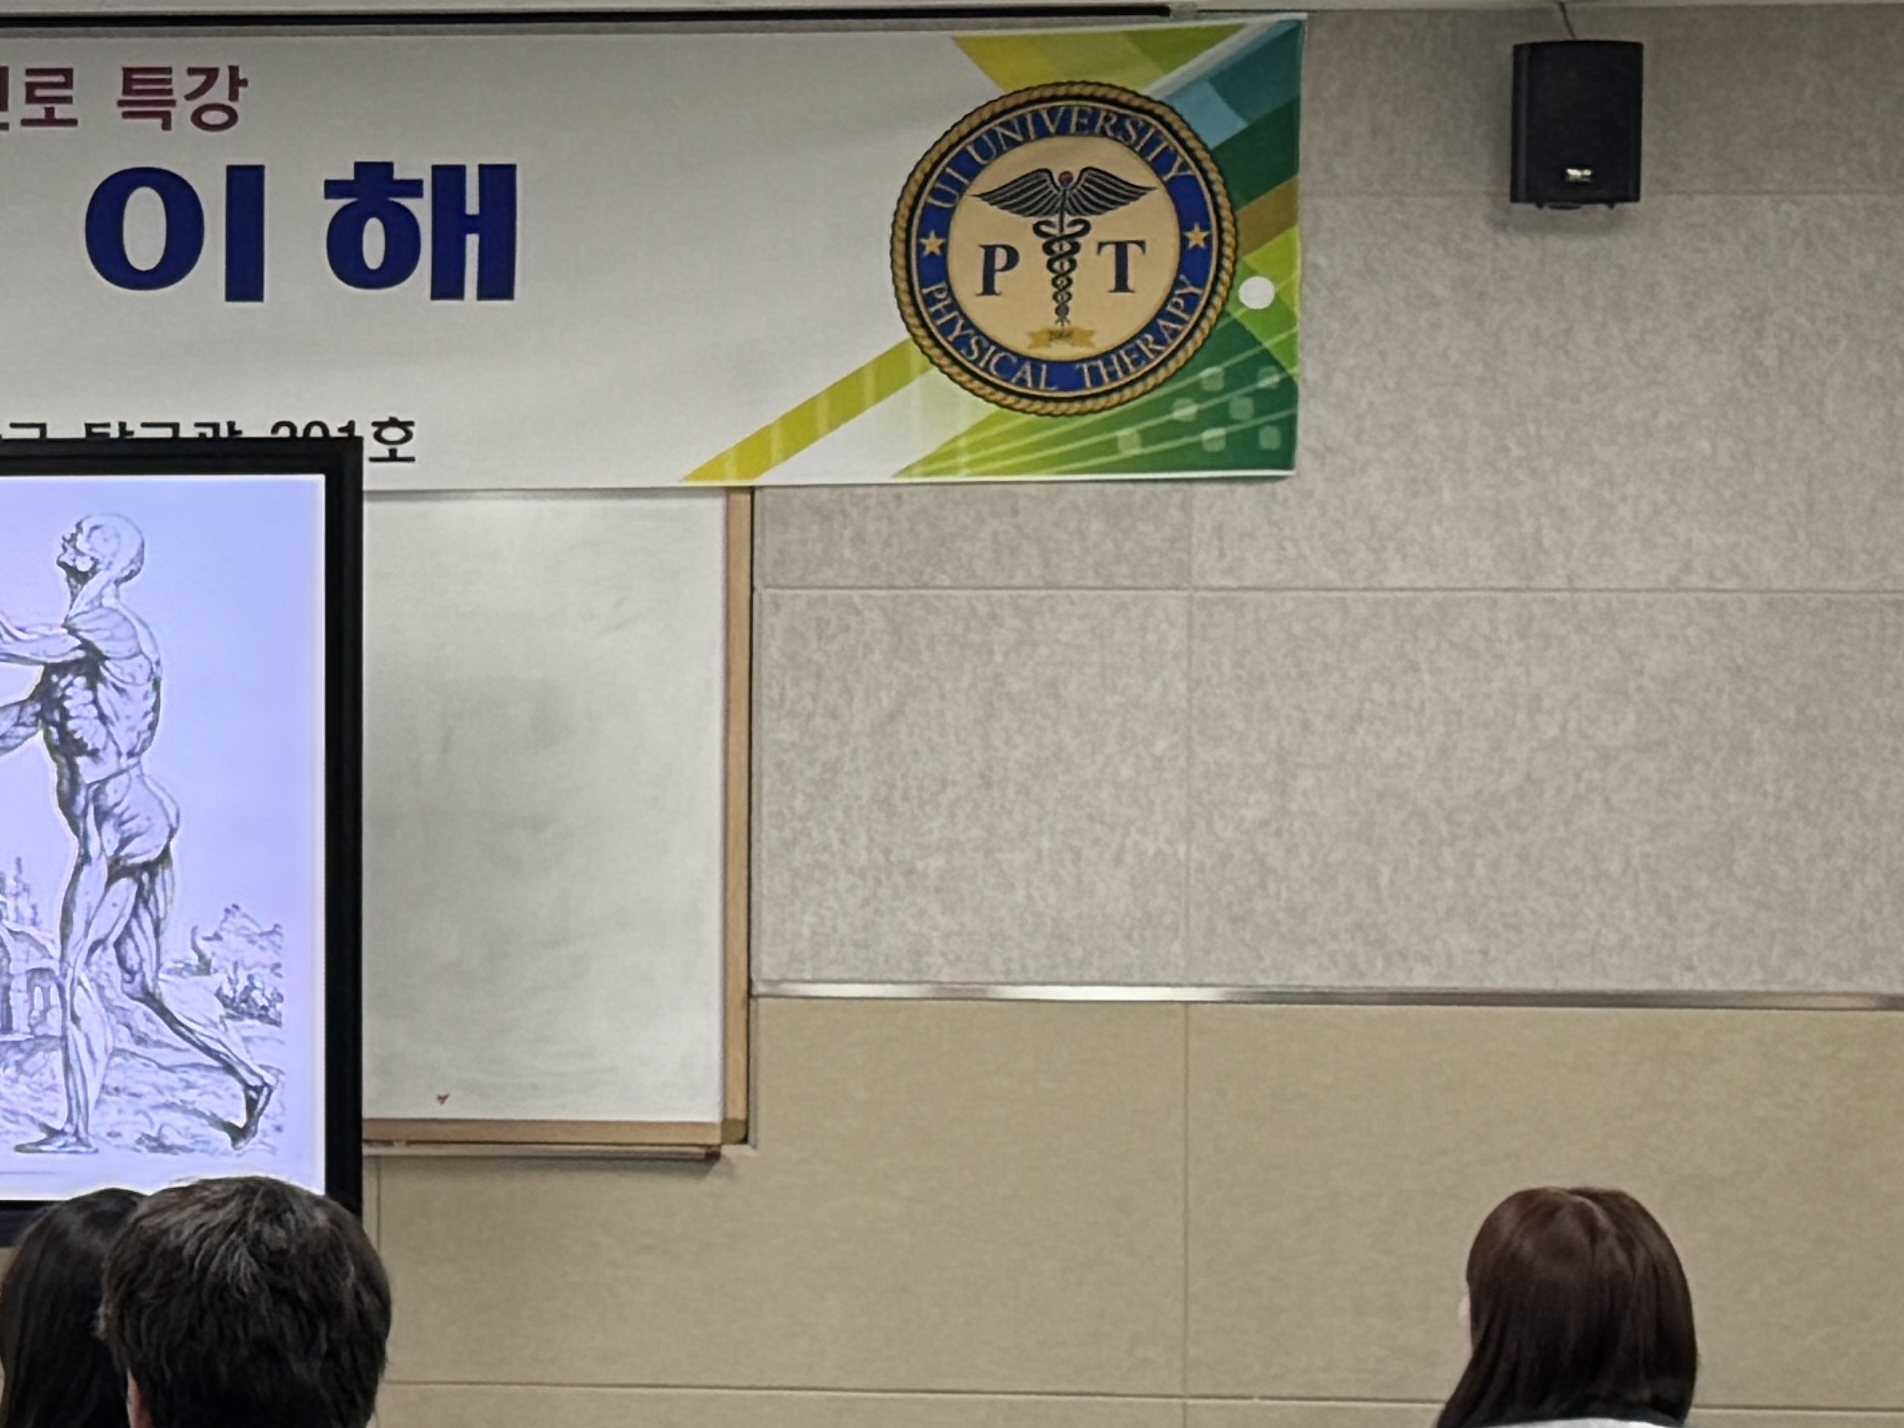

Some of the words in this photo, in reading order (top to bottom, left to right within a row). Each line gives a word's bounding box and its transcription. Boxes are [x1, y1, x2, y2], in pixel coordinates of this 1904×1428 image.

[115, 65, 249, 133] 특강
[968, 106, 1193, 182] UNIVERSITY
[84, 160, 518, 303] 이해
[921, 281, 1059, 391] PHYSICAL
[1076, 274, 1205, 389] THERAPY
